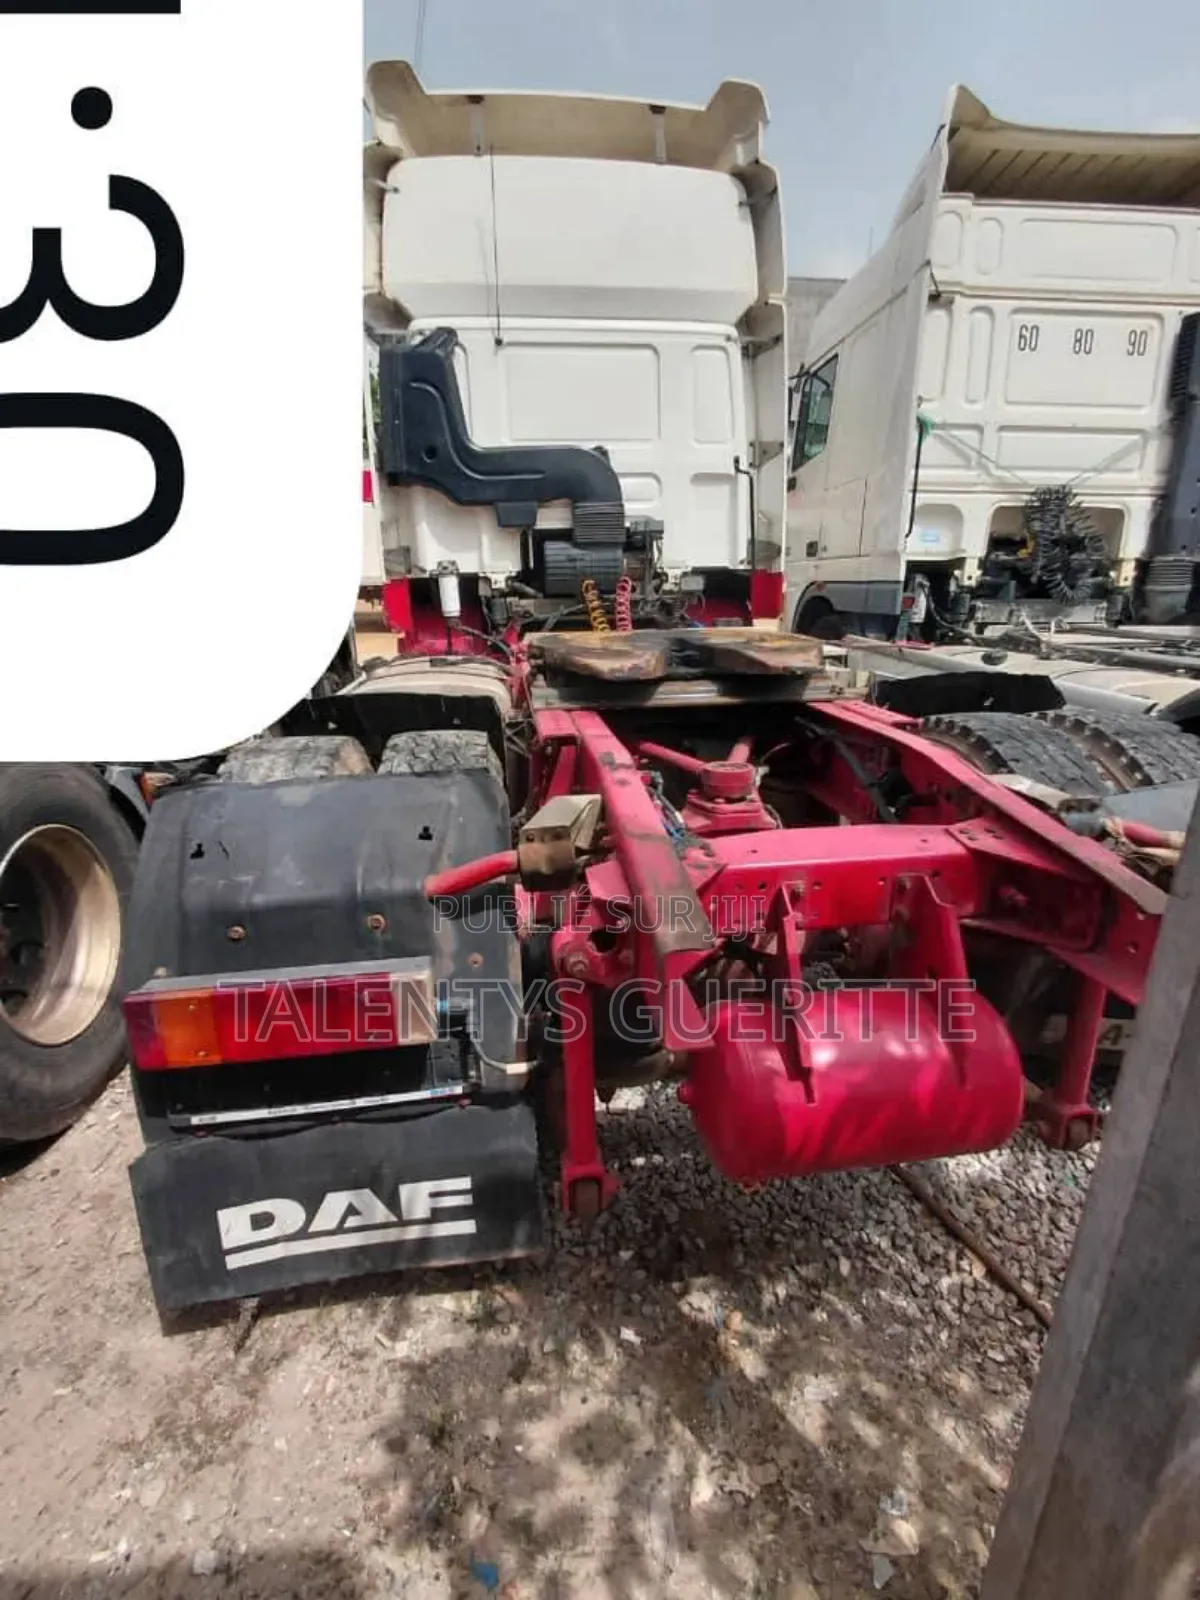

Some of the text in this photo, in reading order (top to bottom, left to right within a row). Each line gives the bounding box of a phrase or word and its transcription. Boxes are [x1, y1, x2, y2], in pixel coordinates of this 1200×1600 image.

[1018, 324, 1148, 357] 60 80 90
[217, 1176, 474, 1250] DAF
